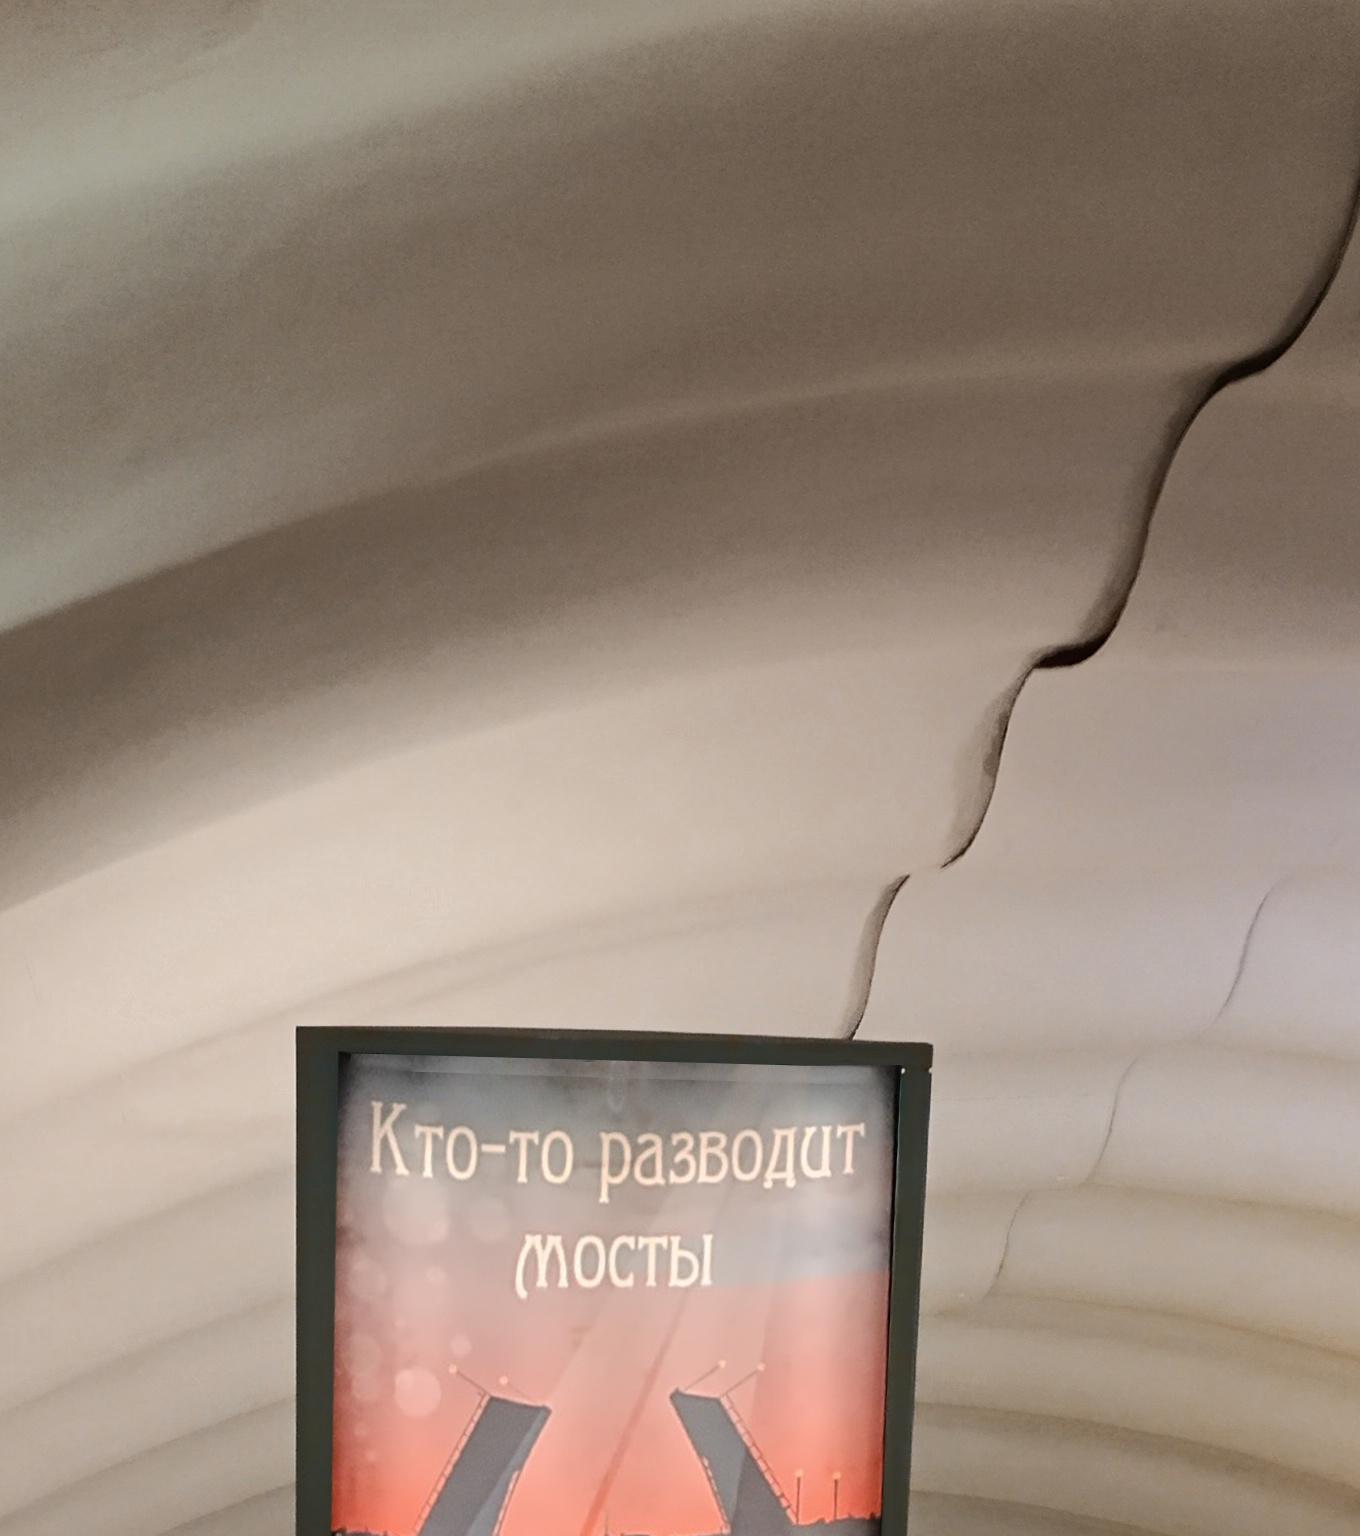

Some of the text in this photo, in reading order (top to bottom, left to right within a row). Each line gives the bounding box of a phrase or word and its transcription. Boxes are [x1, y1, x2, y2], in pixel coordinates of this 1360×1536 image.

[370, 1101, 866, 1204] Кто-то разводит
[514, 1233, 714, 1300] мосты
